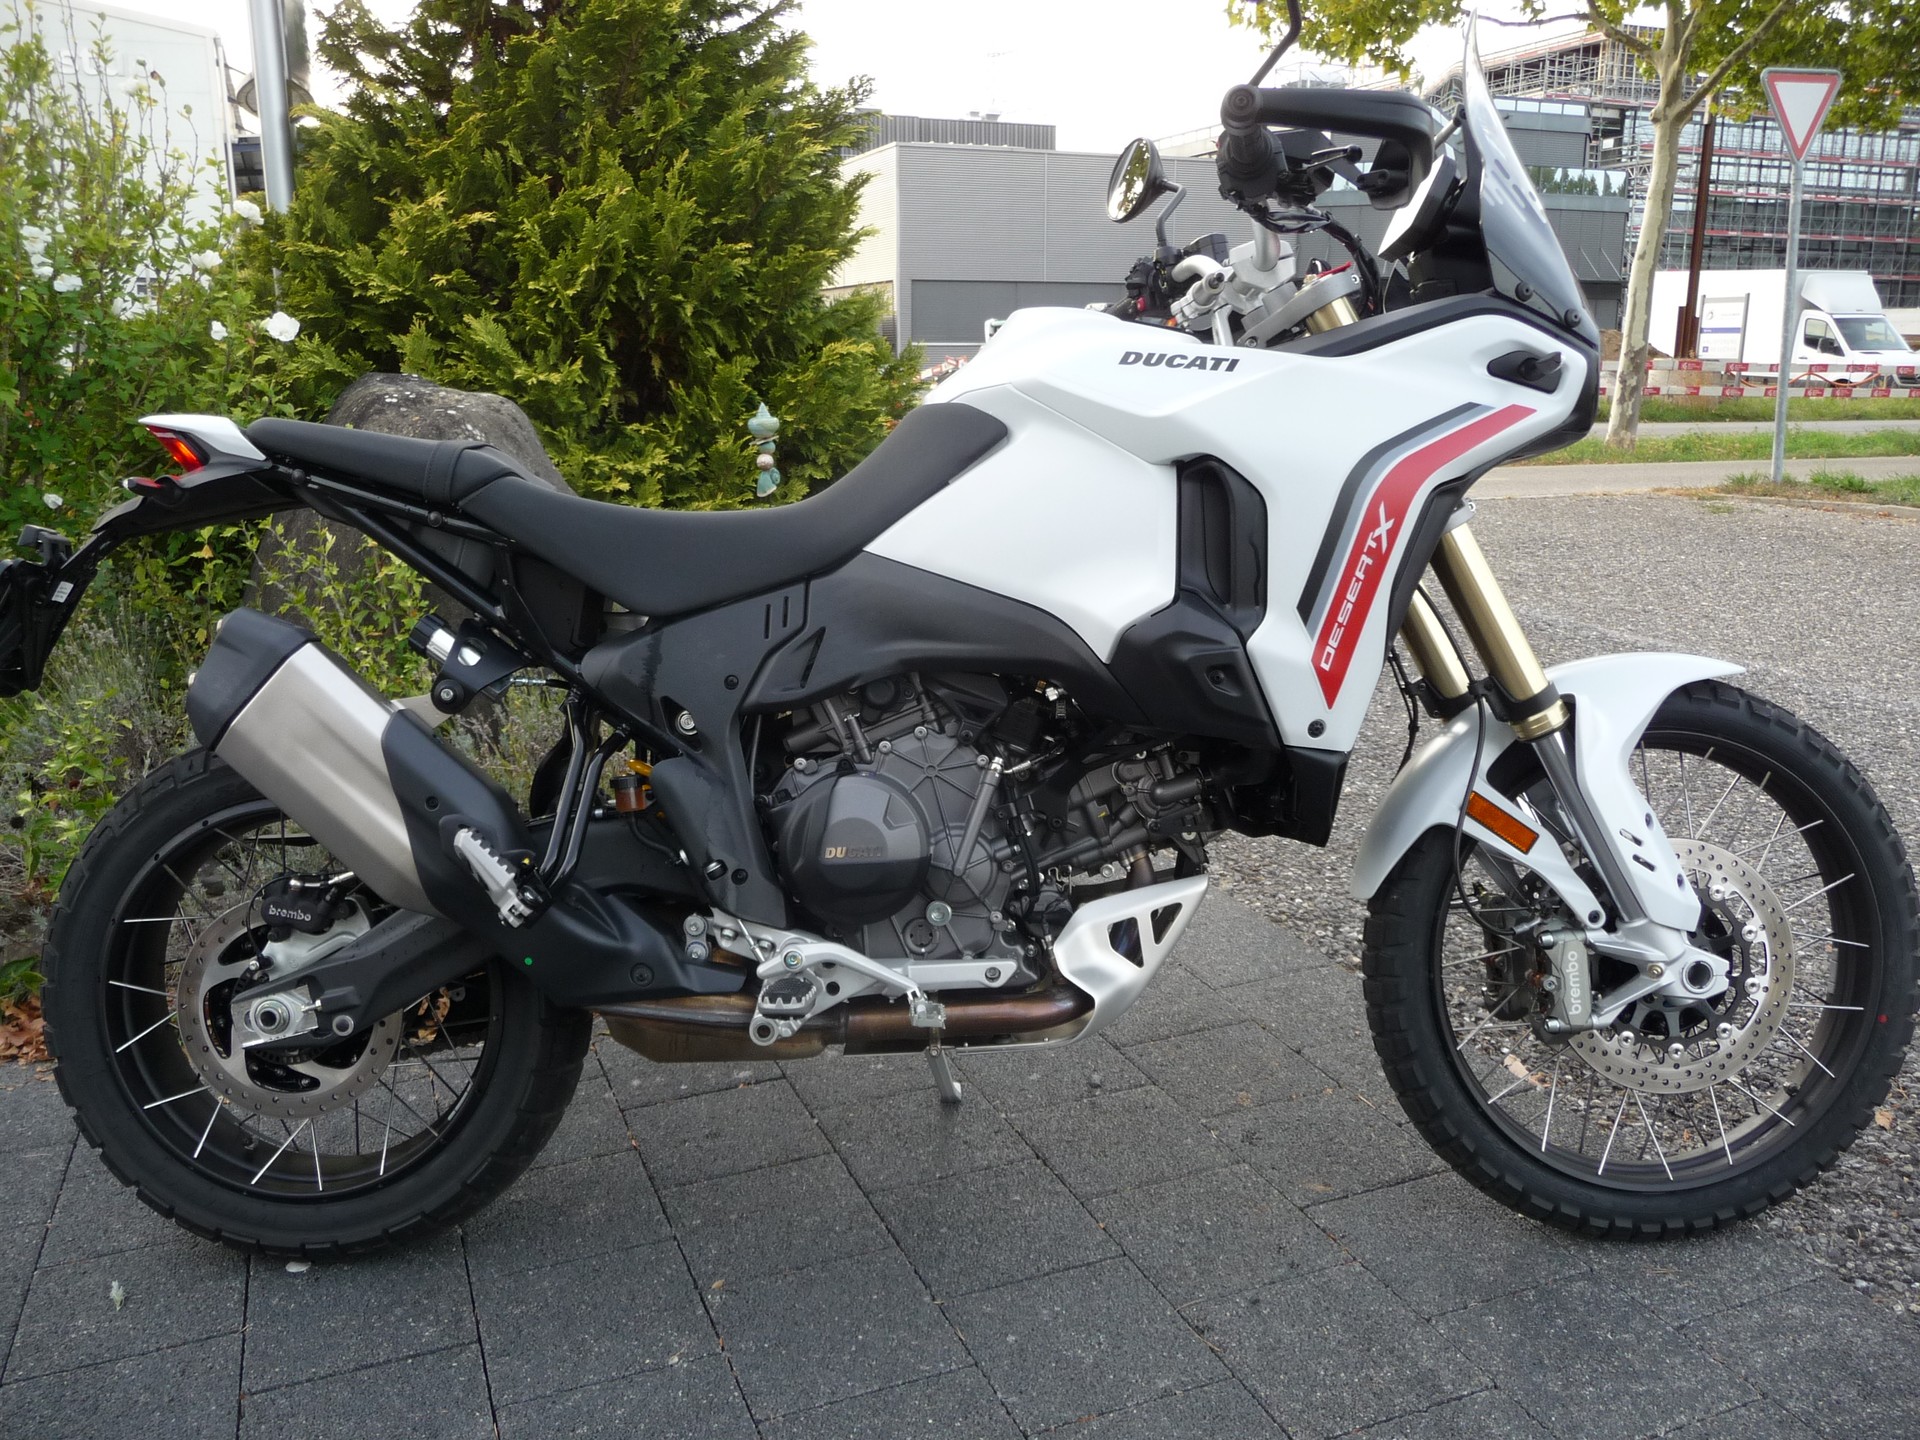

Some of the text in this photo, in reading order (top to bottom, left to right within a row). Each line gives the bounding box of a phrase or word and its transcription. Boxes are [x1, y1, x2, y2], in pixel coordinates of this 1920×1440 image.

[1118, 351, 1240, 373] DUCATI
[1320, 500, 1395, 672] DESERTX
[268, 904, 312, 922] brembo
[1566, 950, 1582, 1016] brembo
